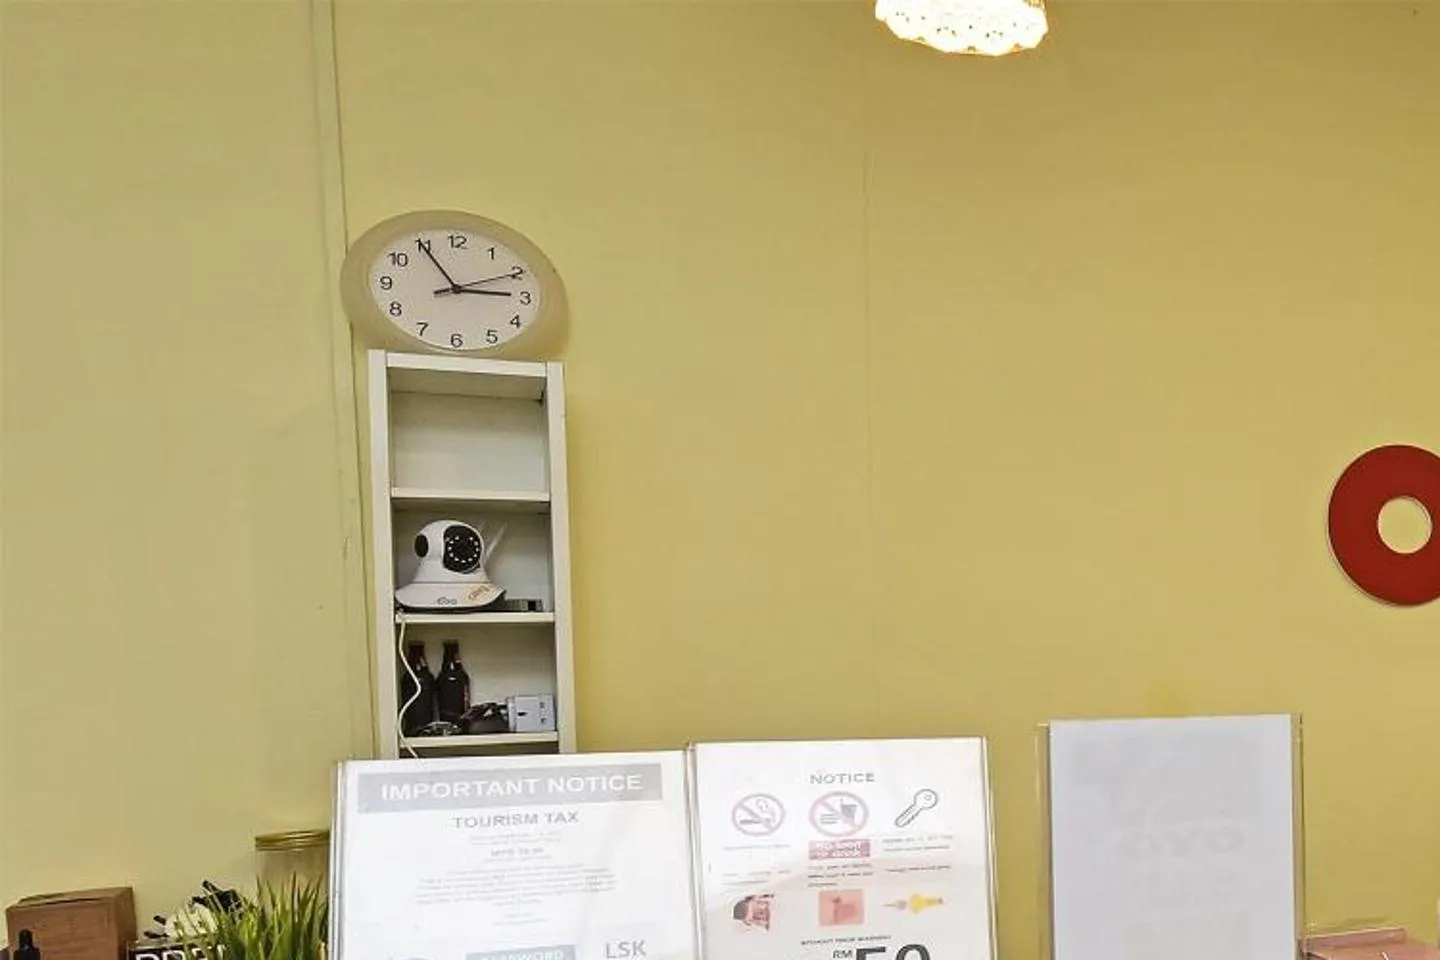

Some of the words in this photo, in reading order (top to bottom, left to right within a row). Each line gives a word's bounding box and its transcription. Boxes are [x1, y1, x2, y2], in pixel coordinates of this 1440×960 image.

[447, 235, 468, 249] 12
[387, 252, 409, 267] 10
[487, 247, 495, 261] 1
[510, 266, 526, 280] 2
[379, 276, 393, 290] 9
[519, 291, 532, 305] 3
[389, 301, 402, 316] 8
[509, 314, 521, 328] 4
[416, 322, 430, 337] 7
[485, 329, 498, 344] 5
[450, 333, 463, 348] 6
[808, 772, 876, 785] NOTICE
[380, 777, 541, 801] IMPORTANT
[547, 774, 644, 794] NOTICE
[451, 812, 539, 830] TOURISM
[547, 810, 581, 824] TAX
[604, 939, 648, 960] LSK
[832, 949, 853, 960] RM
